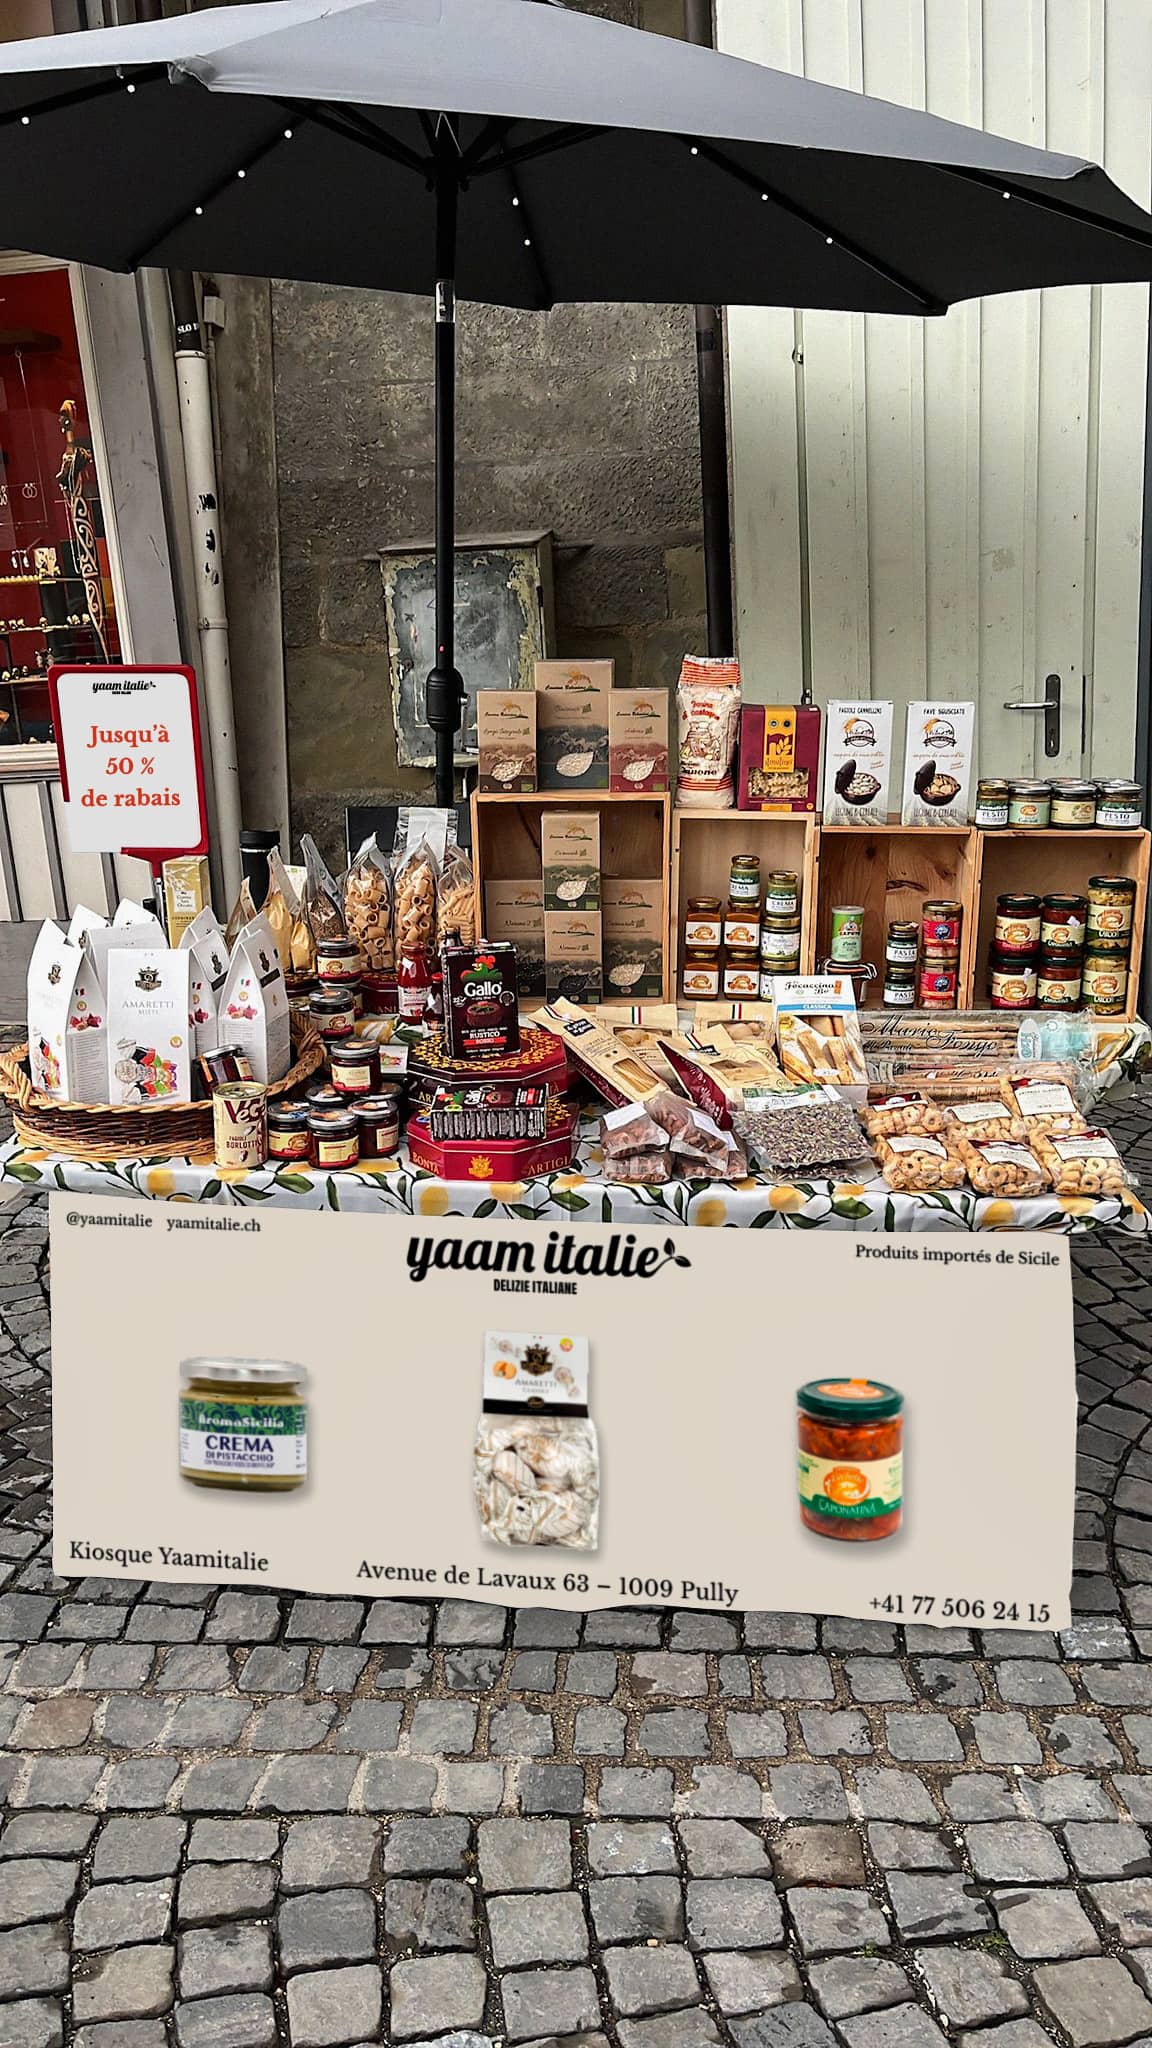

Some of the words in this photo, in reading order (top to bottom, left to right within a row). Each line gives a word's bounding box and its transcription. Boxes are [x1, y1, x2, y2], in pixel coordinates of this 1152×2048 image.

[92, 682, 121, 693] yaam
[123, 680, 149, 690] italie
[86, 724, 170, 748] Jusqu’à
[105, 757, 133, 775] 50
[140, 756, 155, 774] %
[81, 788, 108, 807] de
[113, 787, 181, 807] rabais
[464, 981, 502, 997] Gallo
[122, 1000, 174, 1009] AMARETTI
[860, 1014, 938, 1038] Mario
[66, 1211, 152, 1228] @yaamitalie
[167, 1216, 261, 1232] yaamitalie.ch
[406, 1236, 535, 1282] yaam
[543, 1231, 661, 1279] italie
[855, 1245, 919, 1260] Produits
[923, 1246, 991, 1265] importés
[995, 1250, 1014, 1264] de
[1018, 1251, 1060, 1266] Sicile
[493, 1279, 530, 1293] DELIZIE
[532, 1281, 578, 1295] ITALIANE
[515, 1379, 557, 1388] AMARETTI
[205, 1434, 274, 1453] CREMA
[206, 1450, 215, 1459] DI
[217, 1451, 274, 1462] PISTACCHIO
[70, 1541, 152, 1568] Kiosque
[158, 1547, 269, 1572] Yaamitalie
[356, 1560, 437, 1583] Avenue
[444, 1565, 470, 1585] de
[477, 1568, 556, 1591] Lavaux
[563, 1573, 590, 1593] 63
[619, 1577, 673, 1598] 1009
[681, 1580, 739, 1606] Pully
[869, 1594, 904, 1614] +41
[912, 1595, 936, 1616] 77
[941, 1598, 986, 1619] 506
[993, 1601, 1020, 1622] 24
[1028, 1604, 1051, 1624] 15
